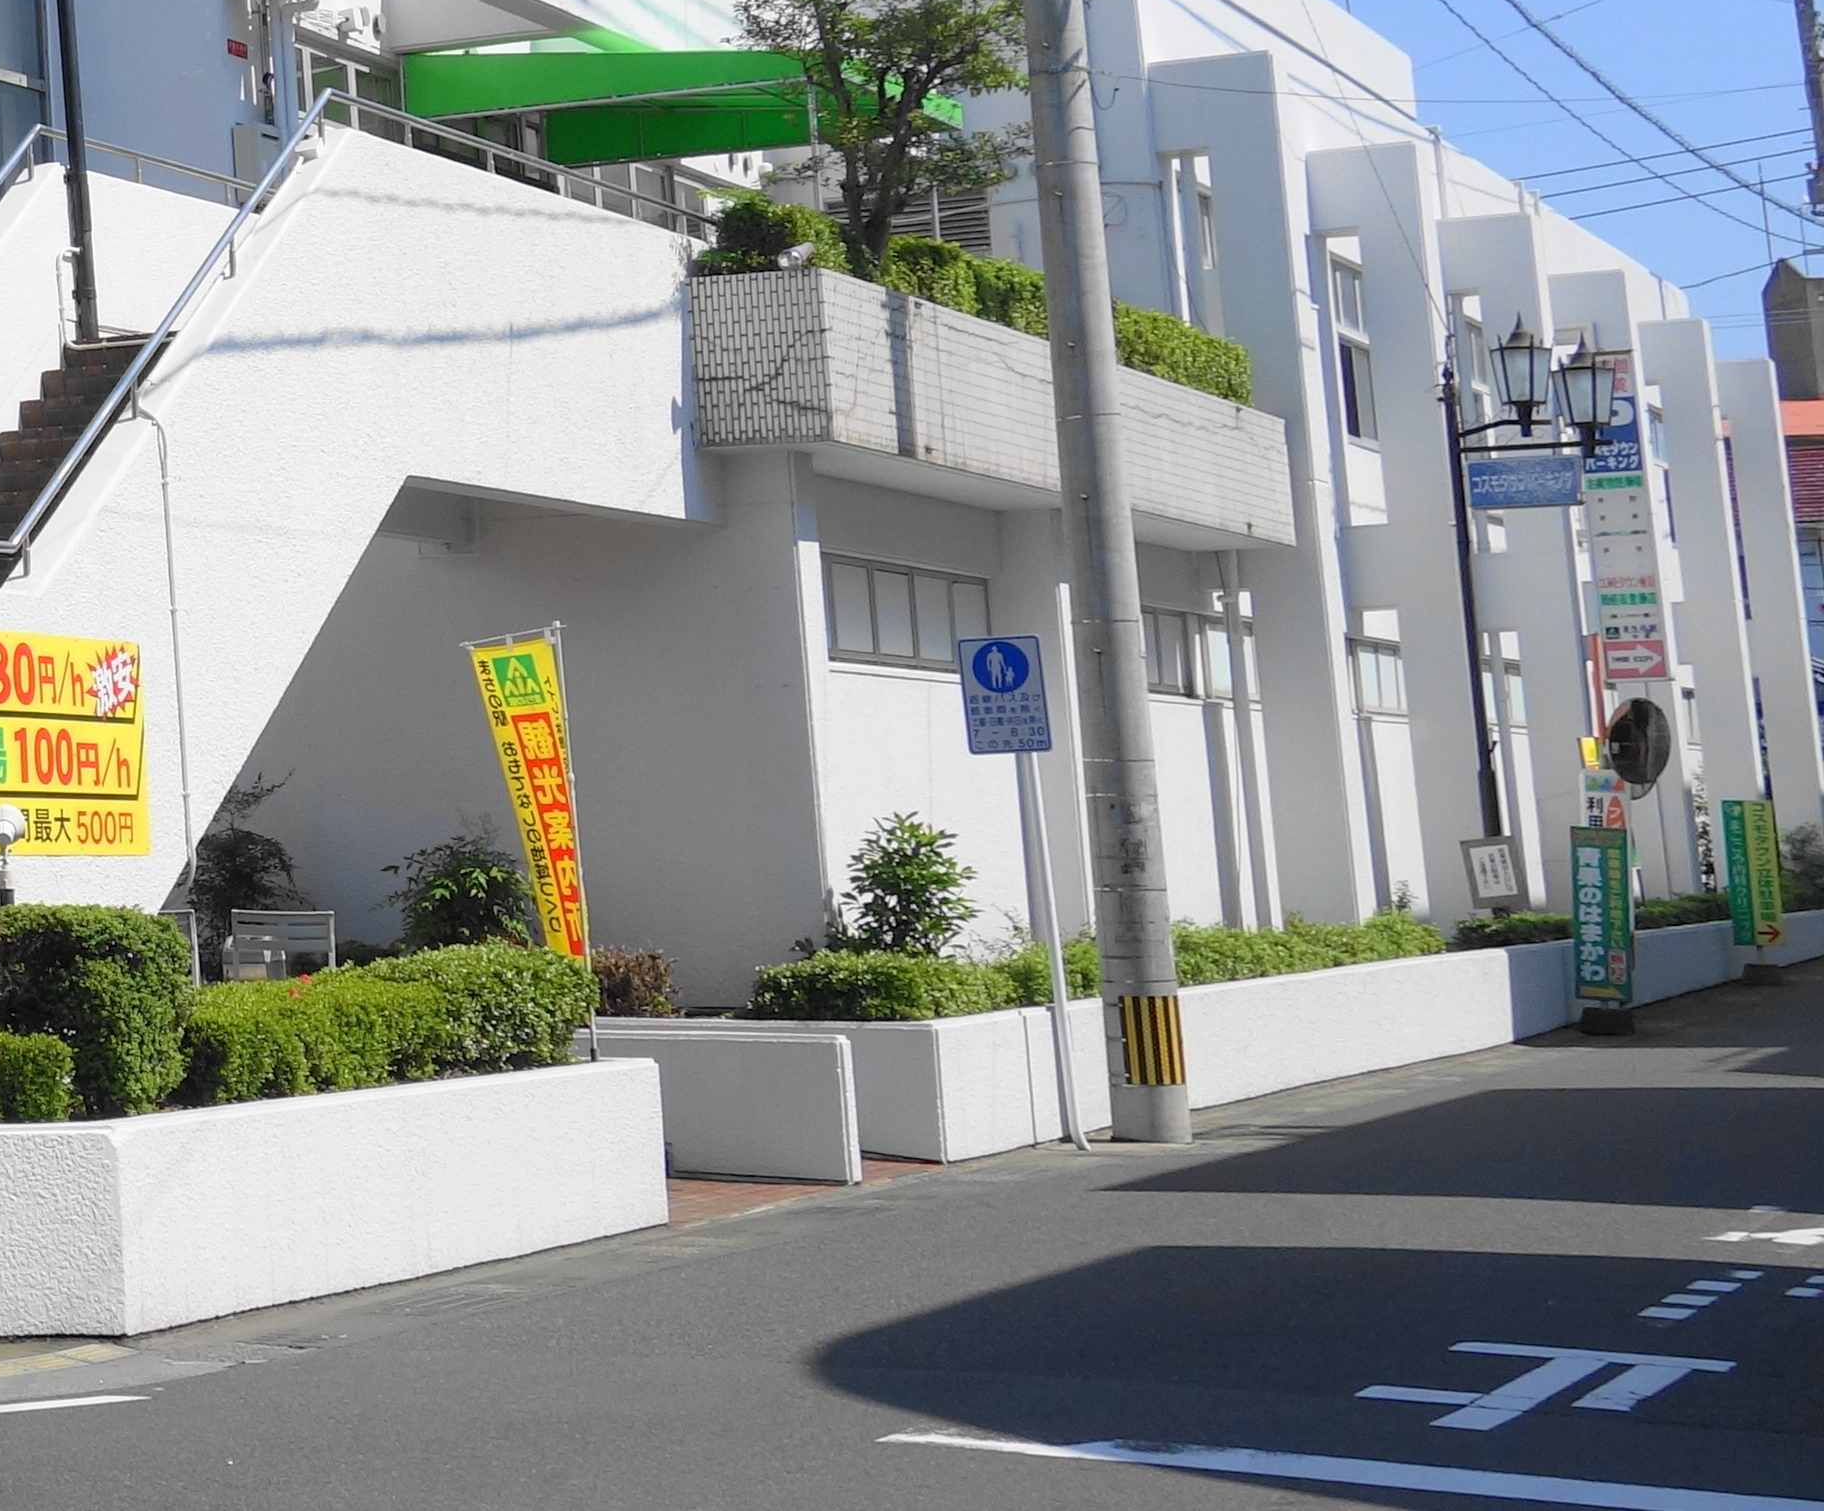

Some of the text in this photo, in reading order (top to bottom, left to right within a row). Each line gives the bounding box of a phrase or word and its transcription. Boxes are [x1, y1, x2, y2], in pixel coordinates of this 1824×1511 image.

[1584, 454, 1641, 472] パーキング
[91, 649, 138, 717] 激安
[12, 726, 131, 789] 100円/h
[75, 810, 135, 845] 500円
